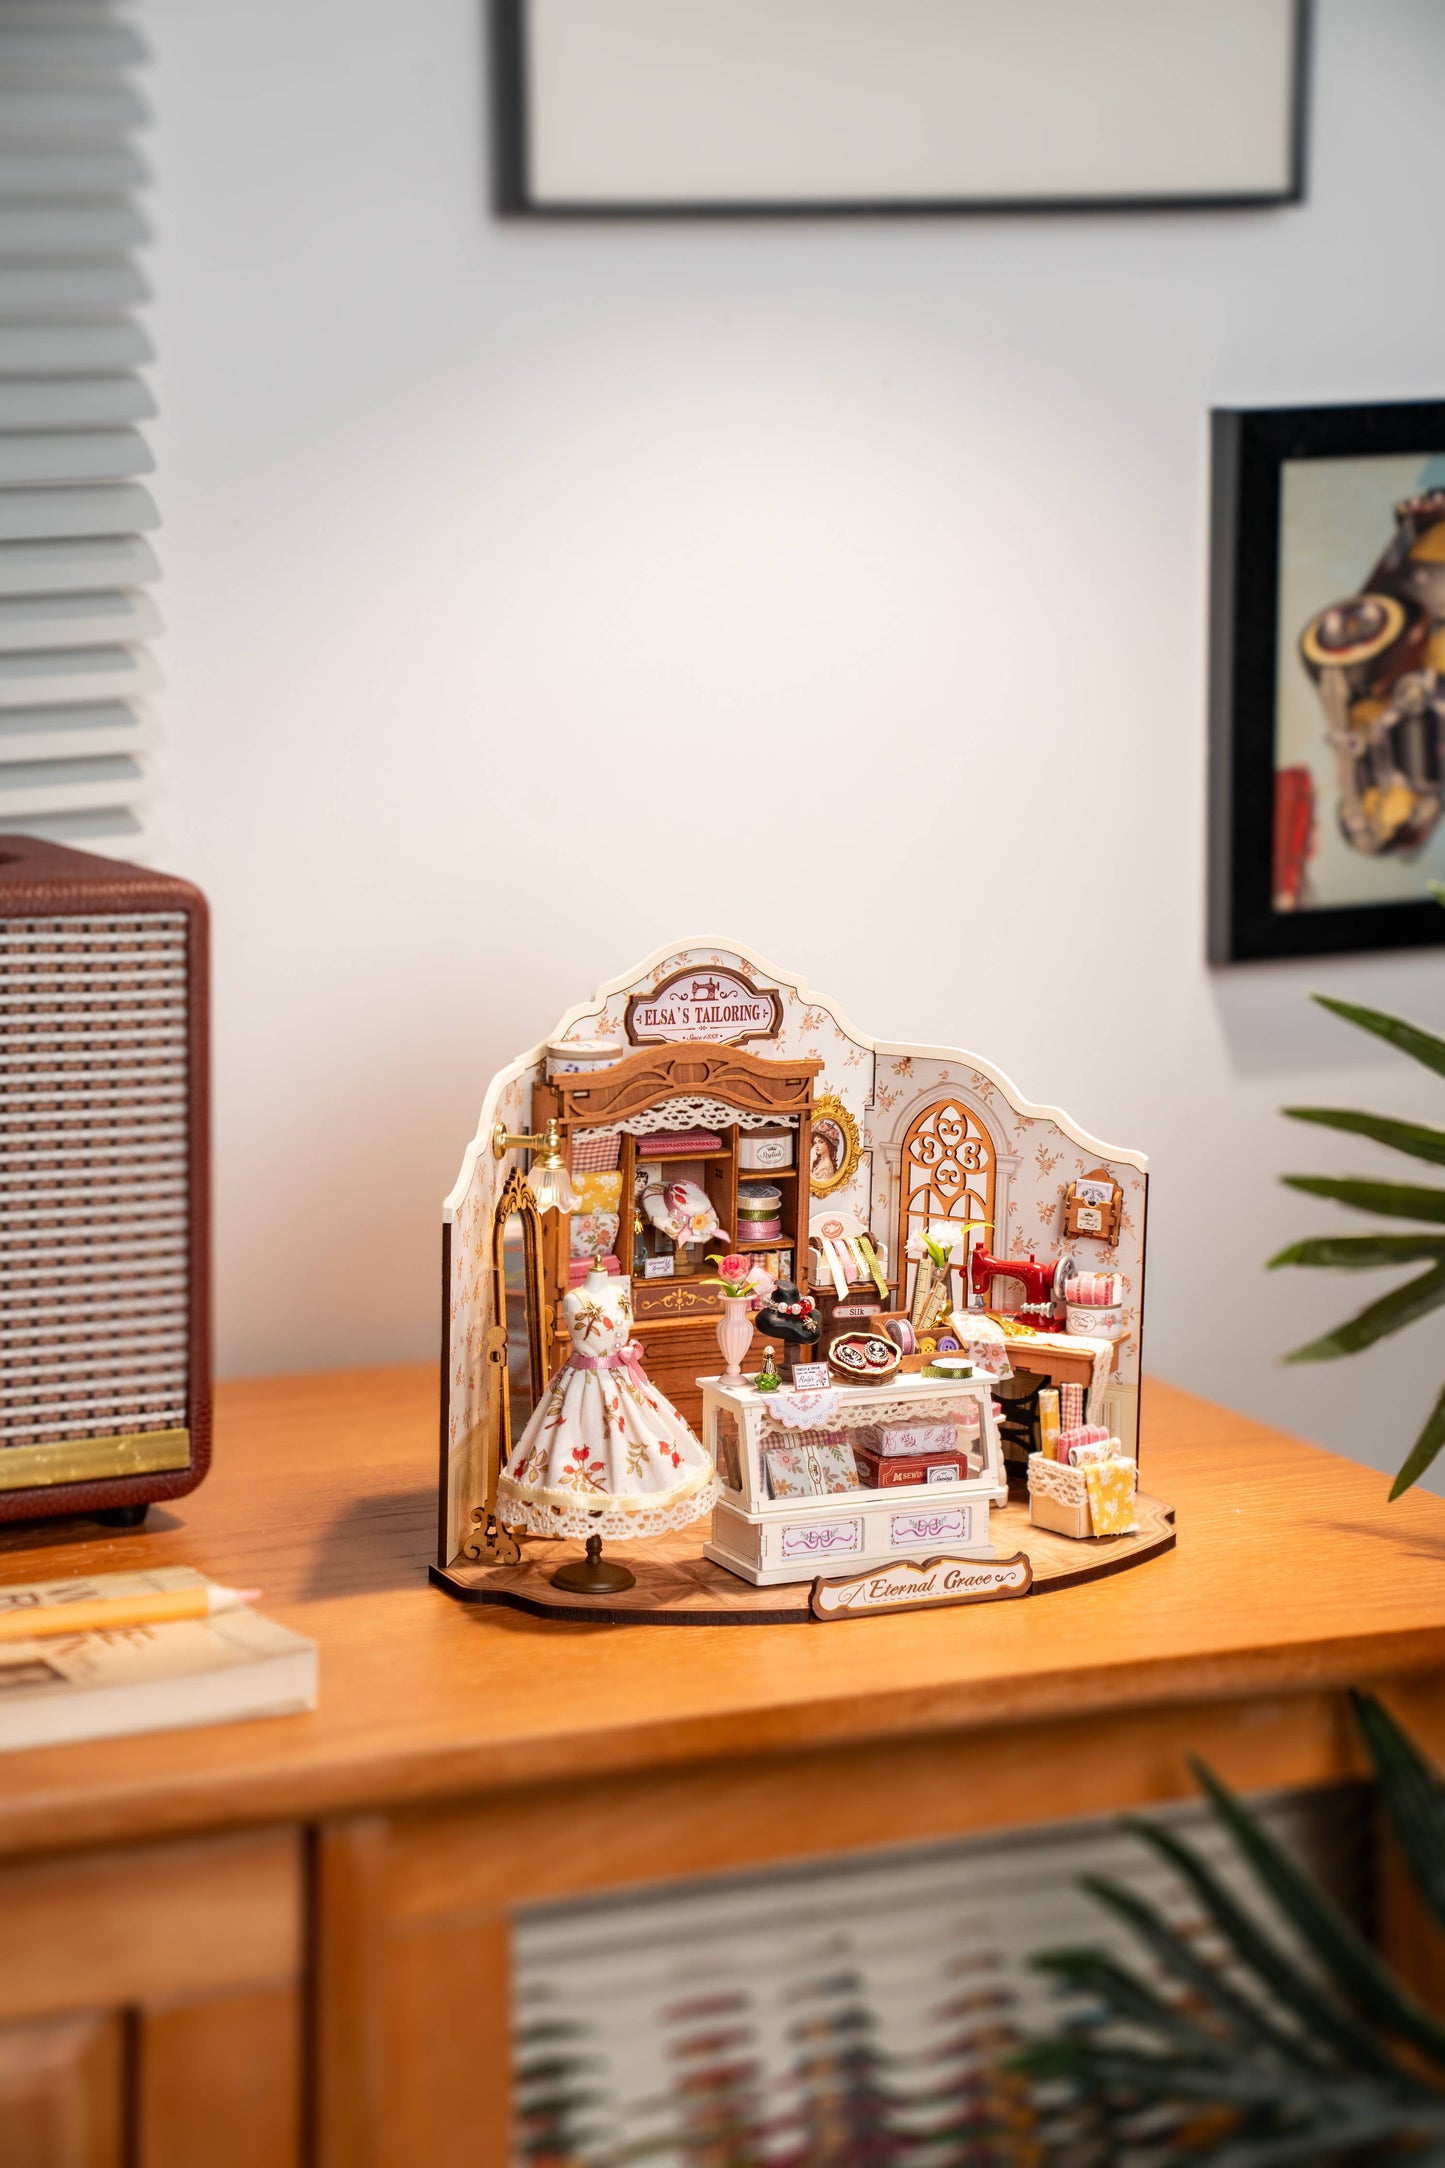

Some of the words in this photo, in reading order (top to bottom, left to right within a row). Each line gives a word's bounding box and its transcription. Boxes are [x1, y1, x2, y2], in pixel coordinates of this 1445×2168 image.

[644, 1007, 690, 1026] ELSA'S
[695, 1004, 760, 1024] TAILORING
[849, 1308, 865, 1316] Silk
[869, 1574, 937, 1599] Eternal
[943, 1569, 993, 1591] Grace
